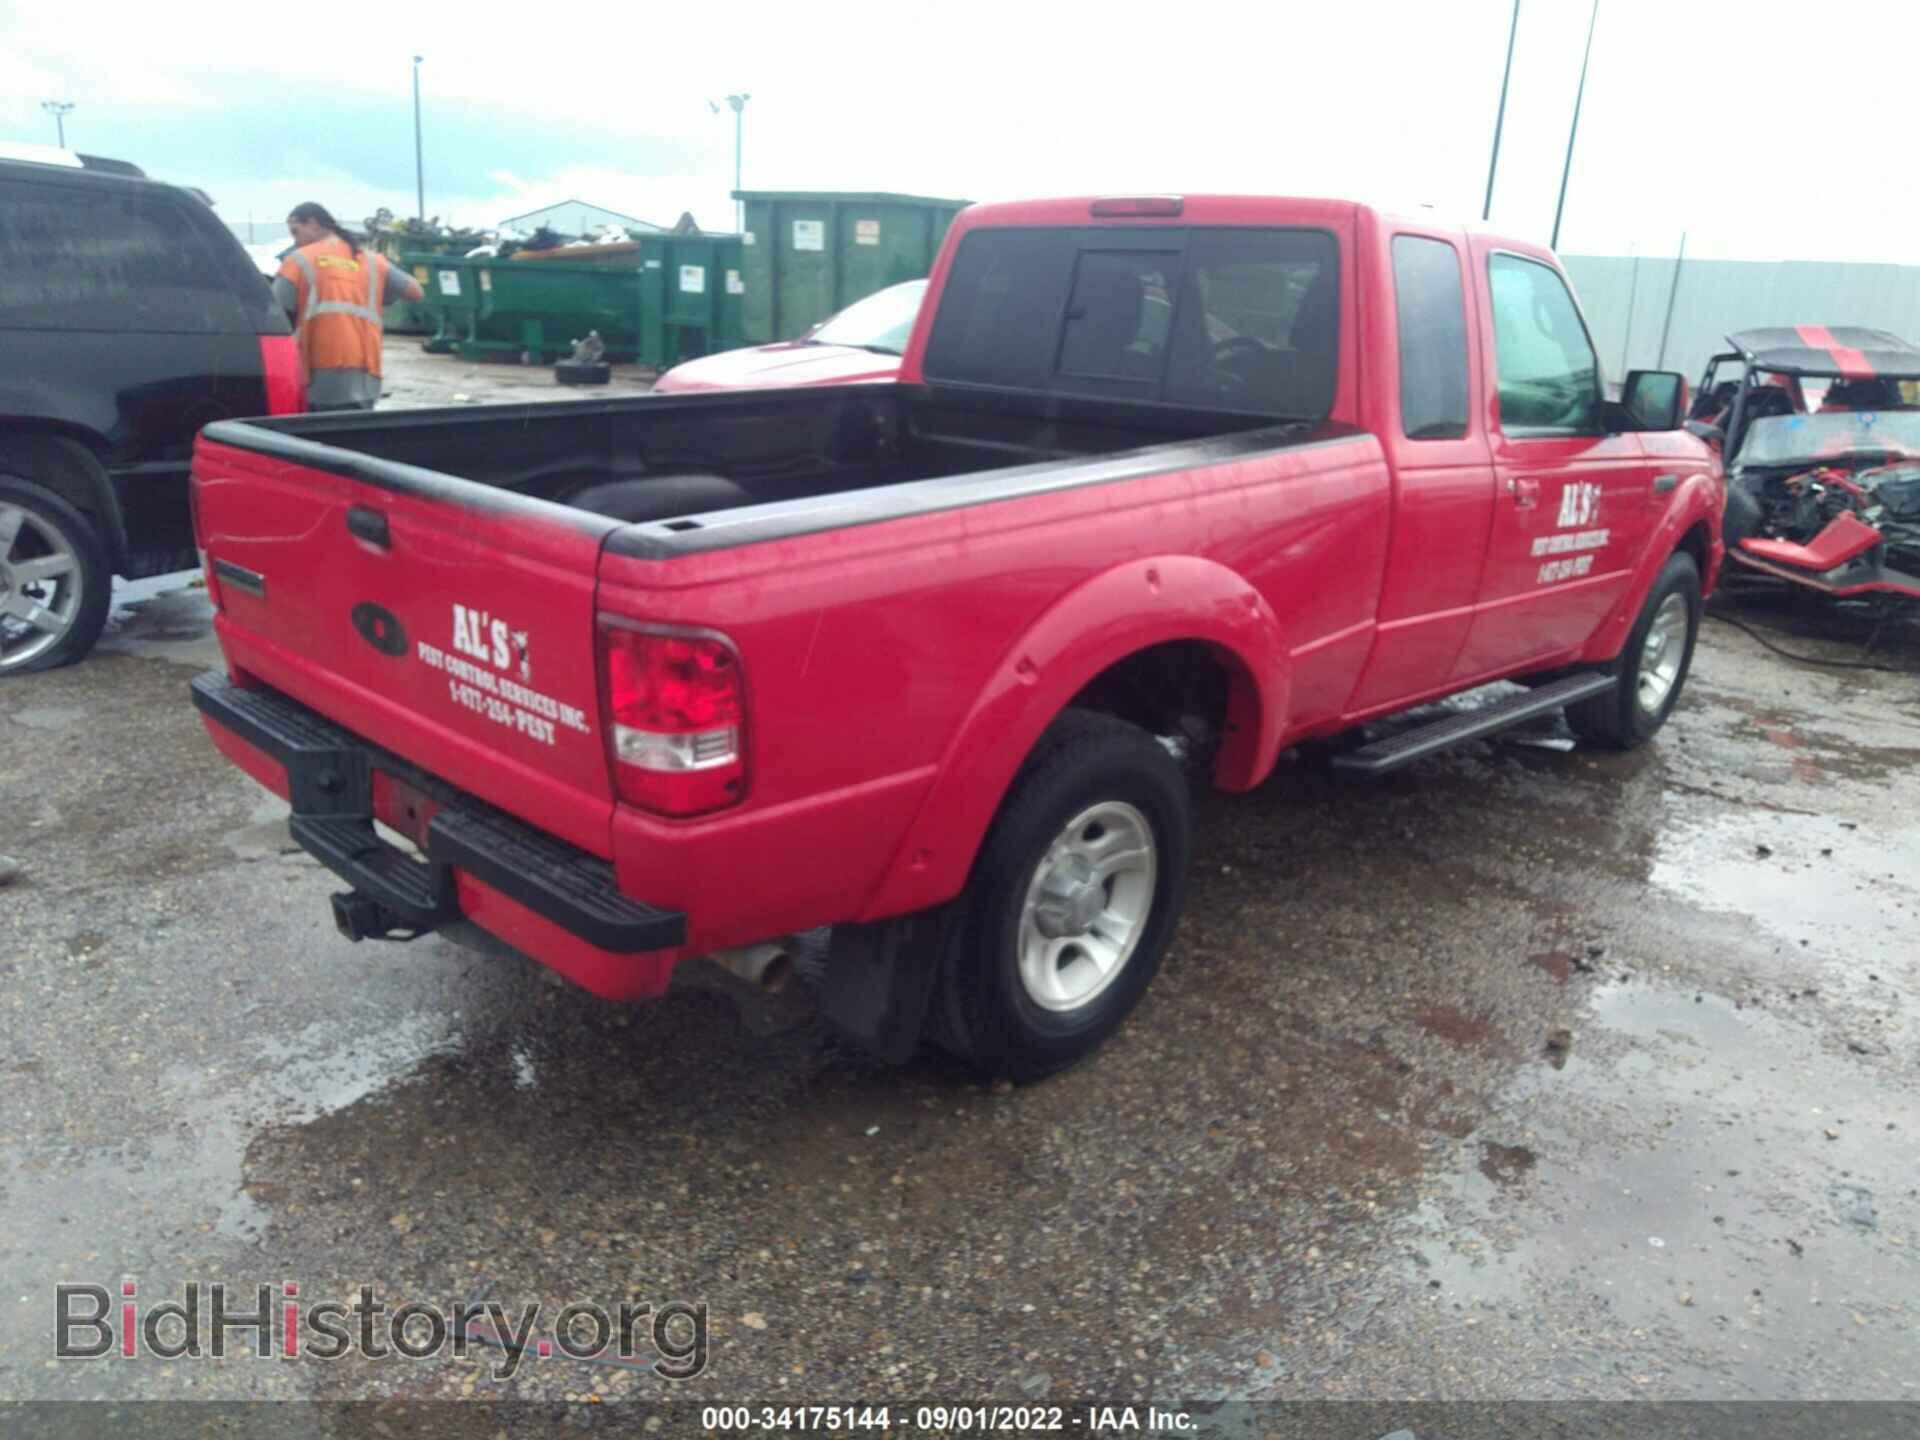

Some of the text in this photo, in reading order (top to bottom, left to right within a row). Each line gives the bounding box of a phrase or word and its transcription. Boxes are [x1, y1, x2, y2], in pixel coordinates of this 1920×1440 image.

[453, 603, 510, 670] AL'S
[417, 641, 590, 734] PEST CONTROL SERVICES INC.
